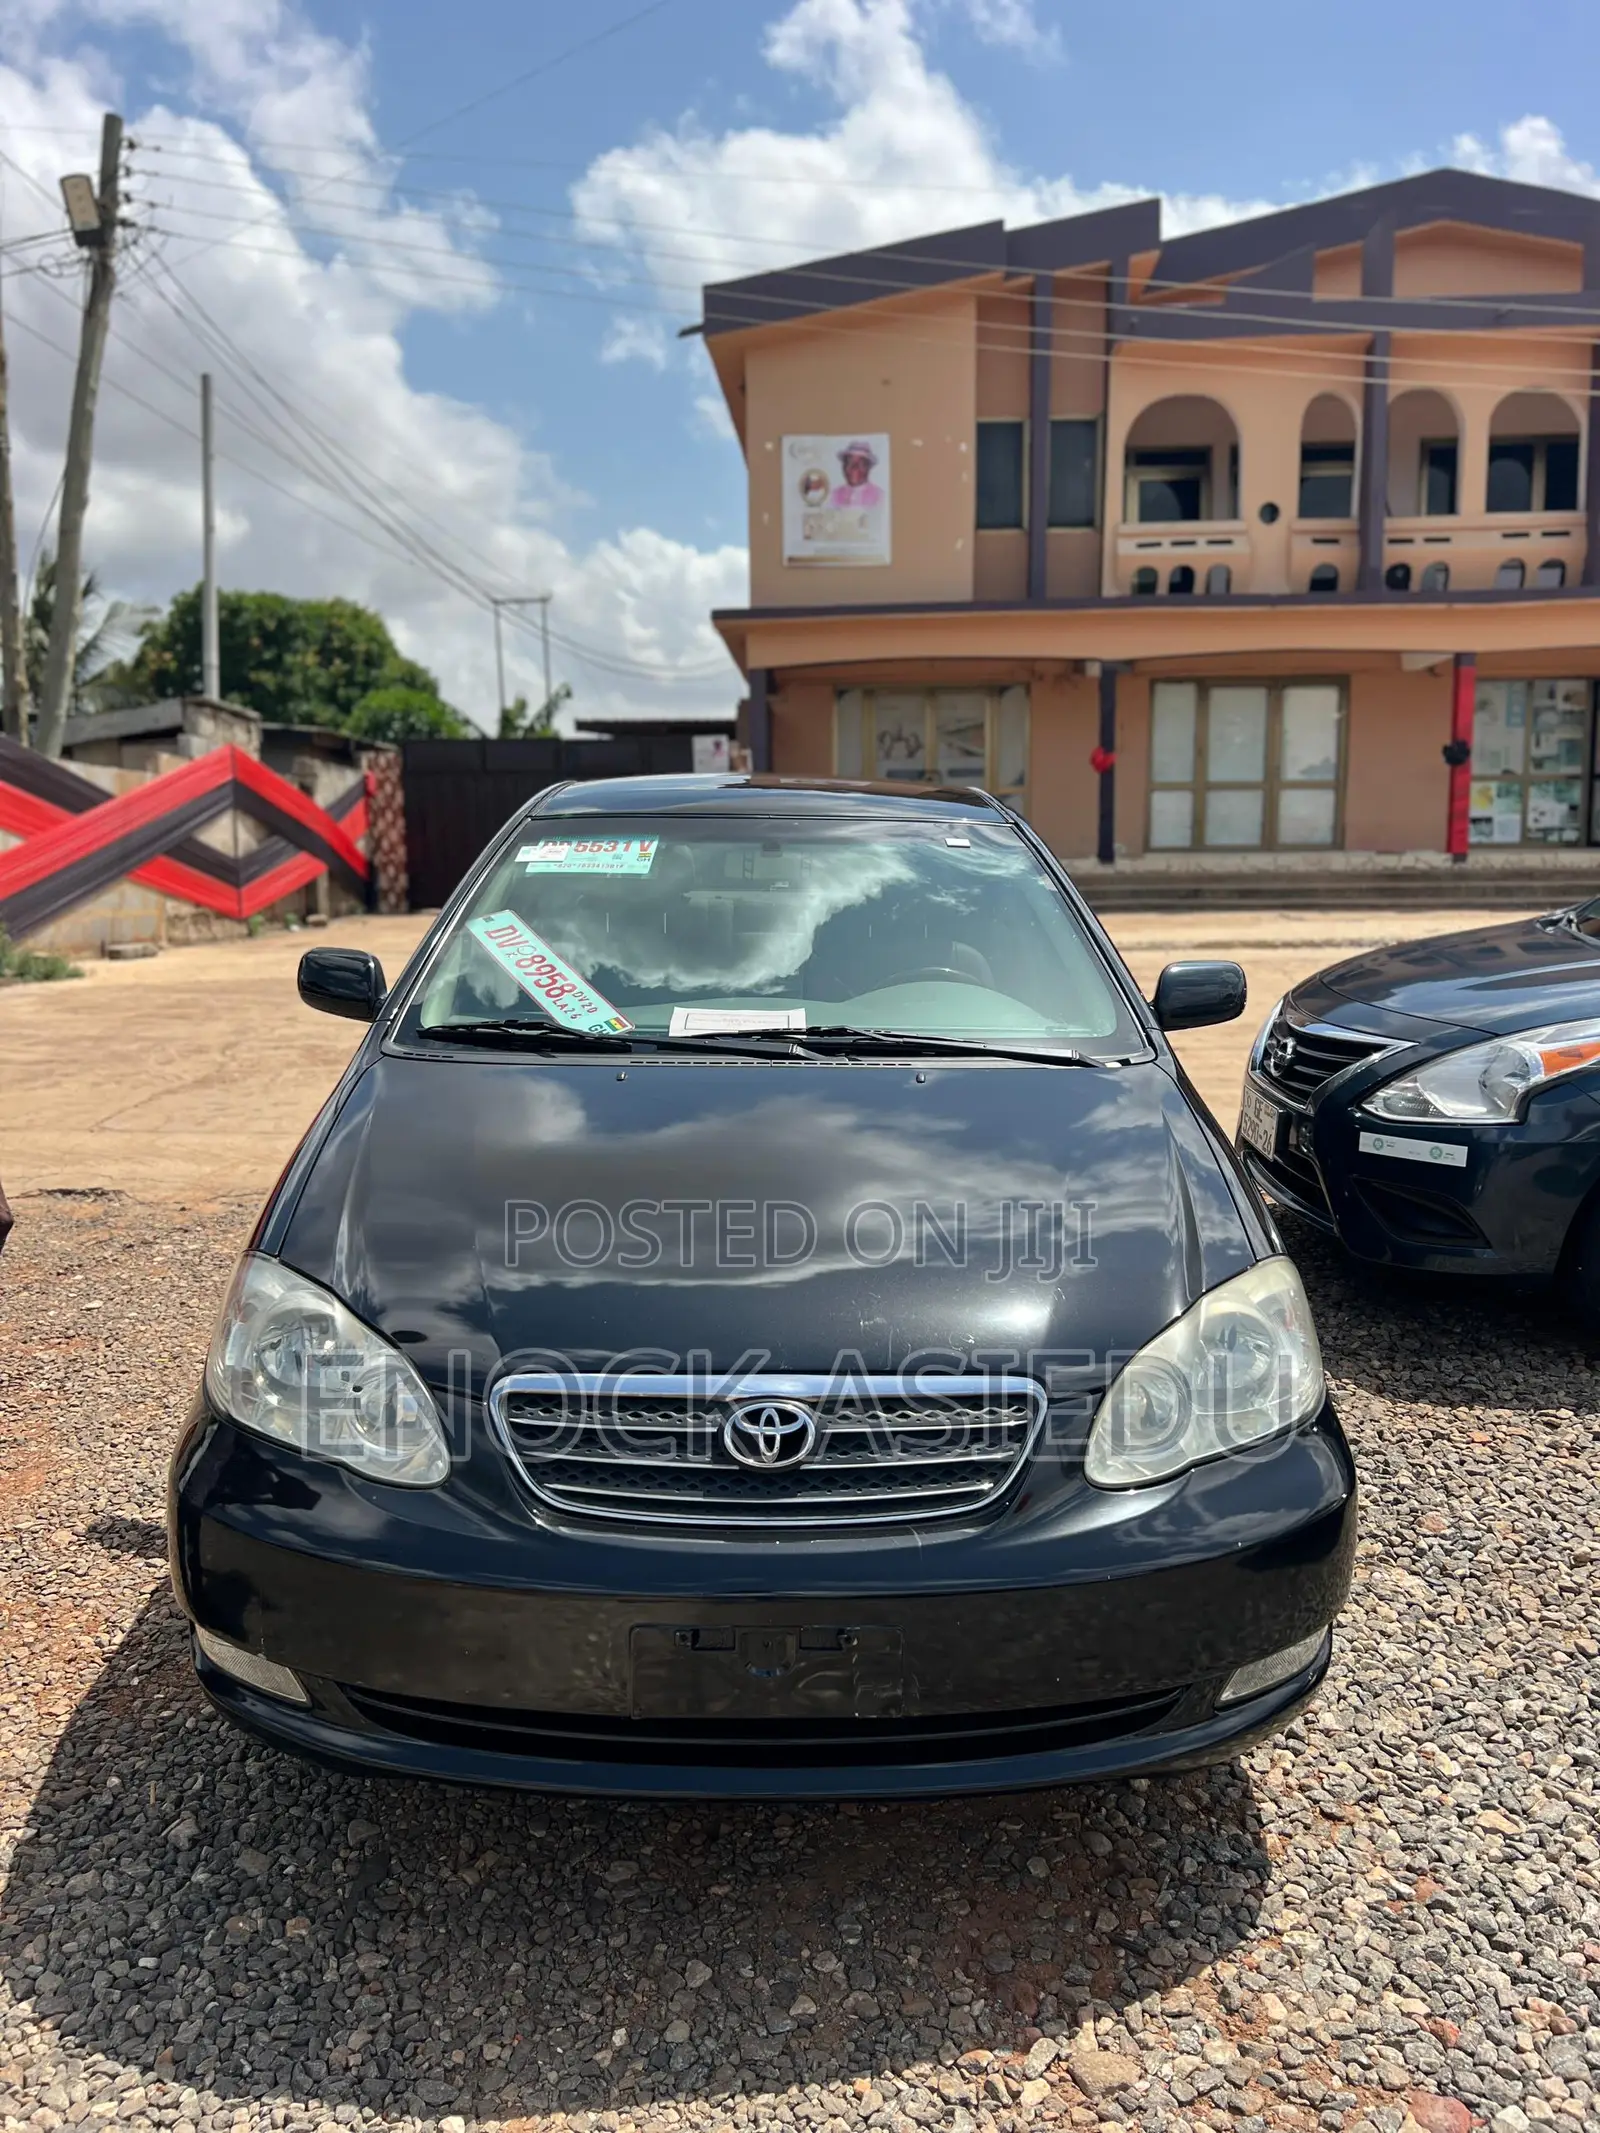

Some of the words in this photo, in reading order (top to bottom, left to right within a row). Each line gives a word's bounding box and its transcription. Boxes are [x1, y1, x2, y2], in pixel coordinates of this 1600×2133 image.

[573, 839, 632, 853] 5531
[639, 839, 656, 853] V
[484, 924, 529, 950] DV
[515, 954, 577, 999] 8958
